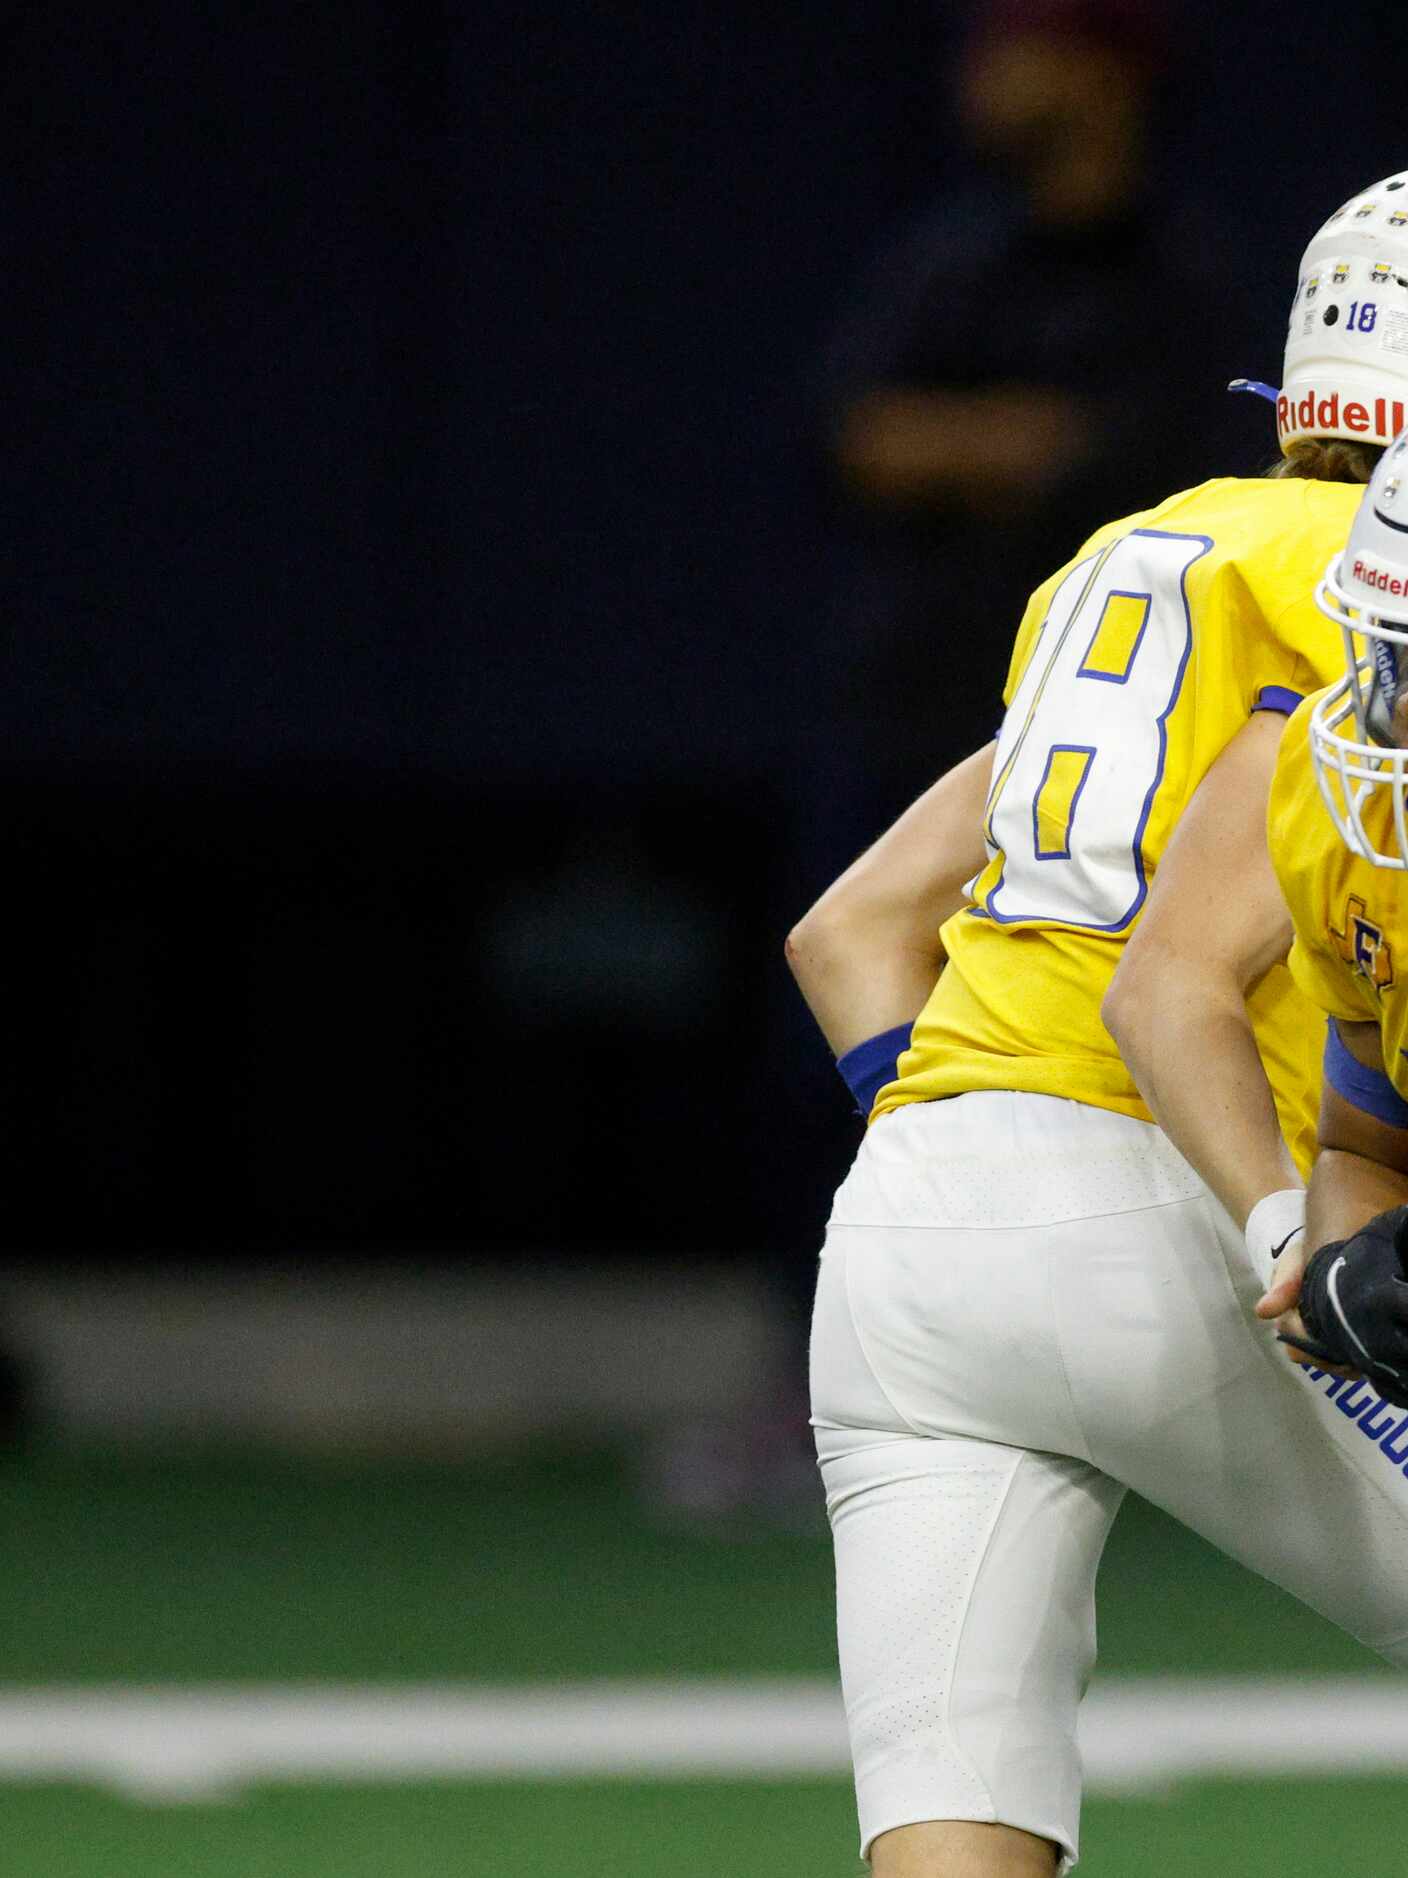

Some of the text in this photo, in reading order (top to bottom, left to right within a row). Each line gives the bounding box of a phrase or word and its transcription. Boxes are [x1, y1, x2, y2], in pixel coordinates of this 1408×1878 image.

[1346, 301, 1377, 333] 18
[1278, 389, 1404, 438] Riddell
[963, 528, 1214, 933] 18
